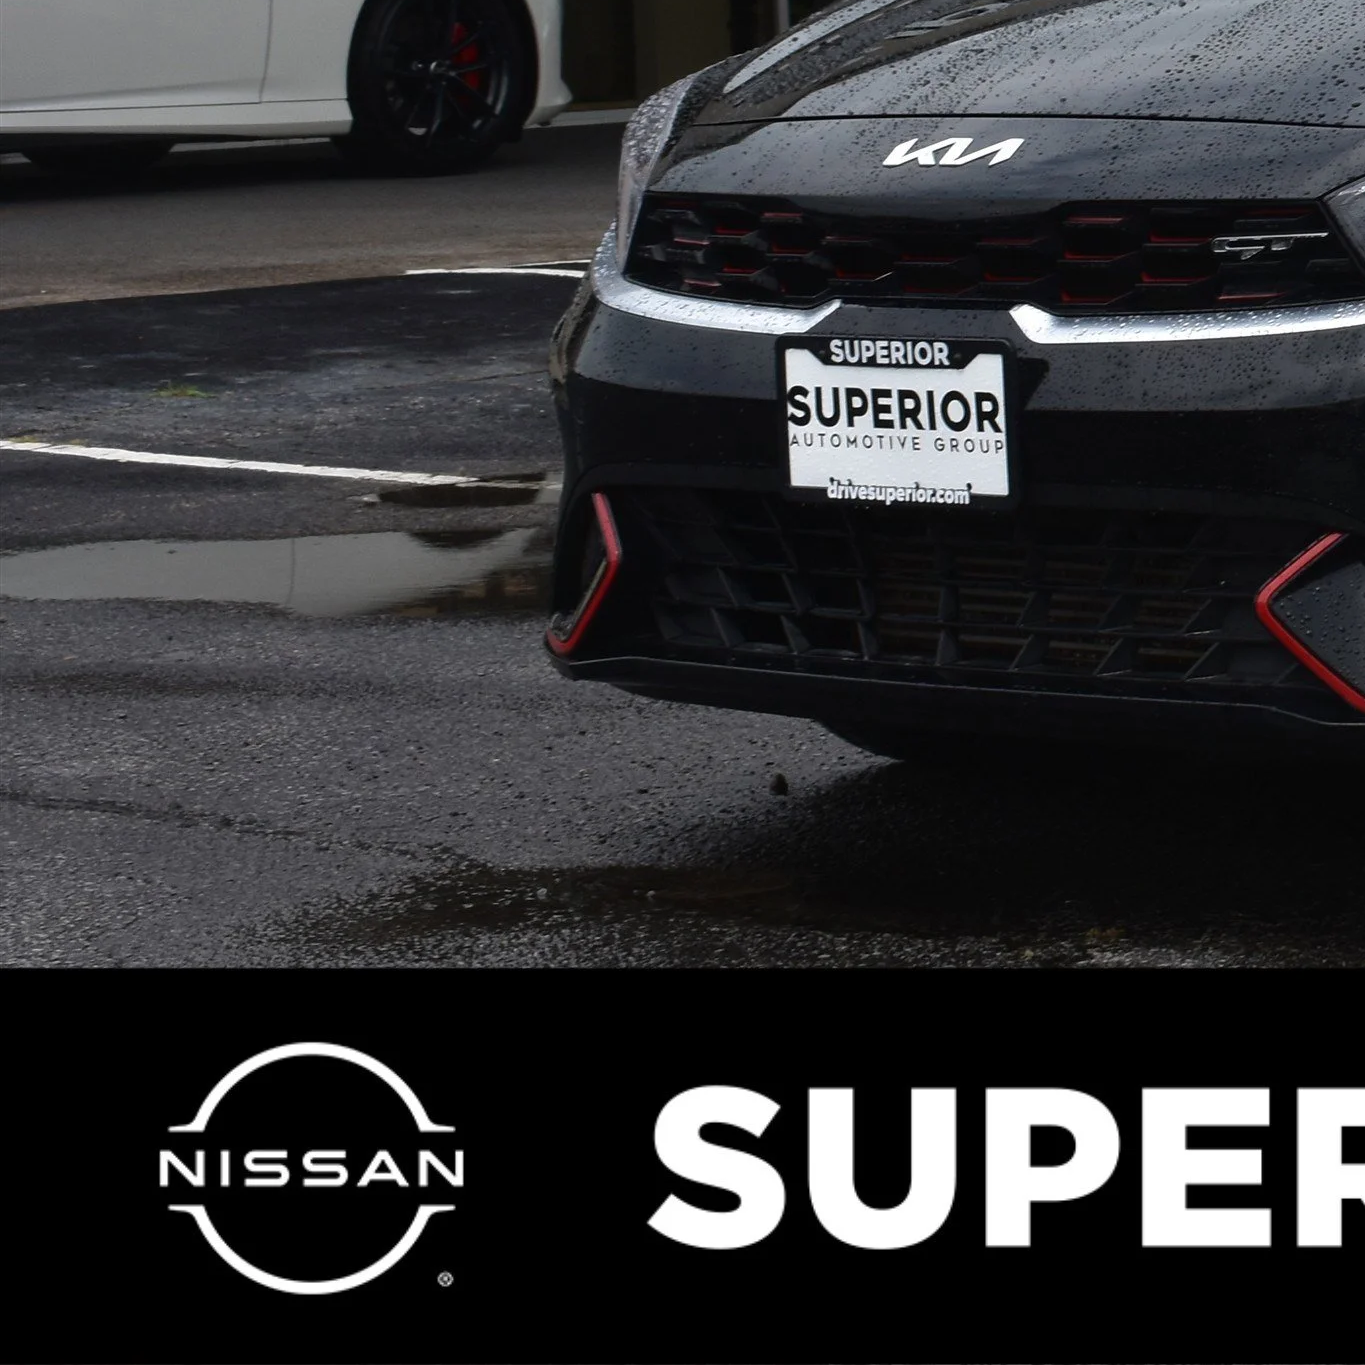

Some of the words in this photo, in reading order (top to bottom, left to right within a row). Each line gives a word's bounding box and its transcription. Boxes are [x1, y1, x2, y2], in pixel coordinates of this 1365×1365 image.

[829, 339, 950, 366] SUPERIOR
[786, 385, 1004, 433] SUPERIOR
[789, 433, 921, 451] AUTOMOTIVE
[933, 438, 1005, 454] GROUP
[827, 478, 971, 506] drivesuperior.com
